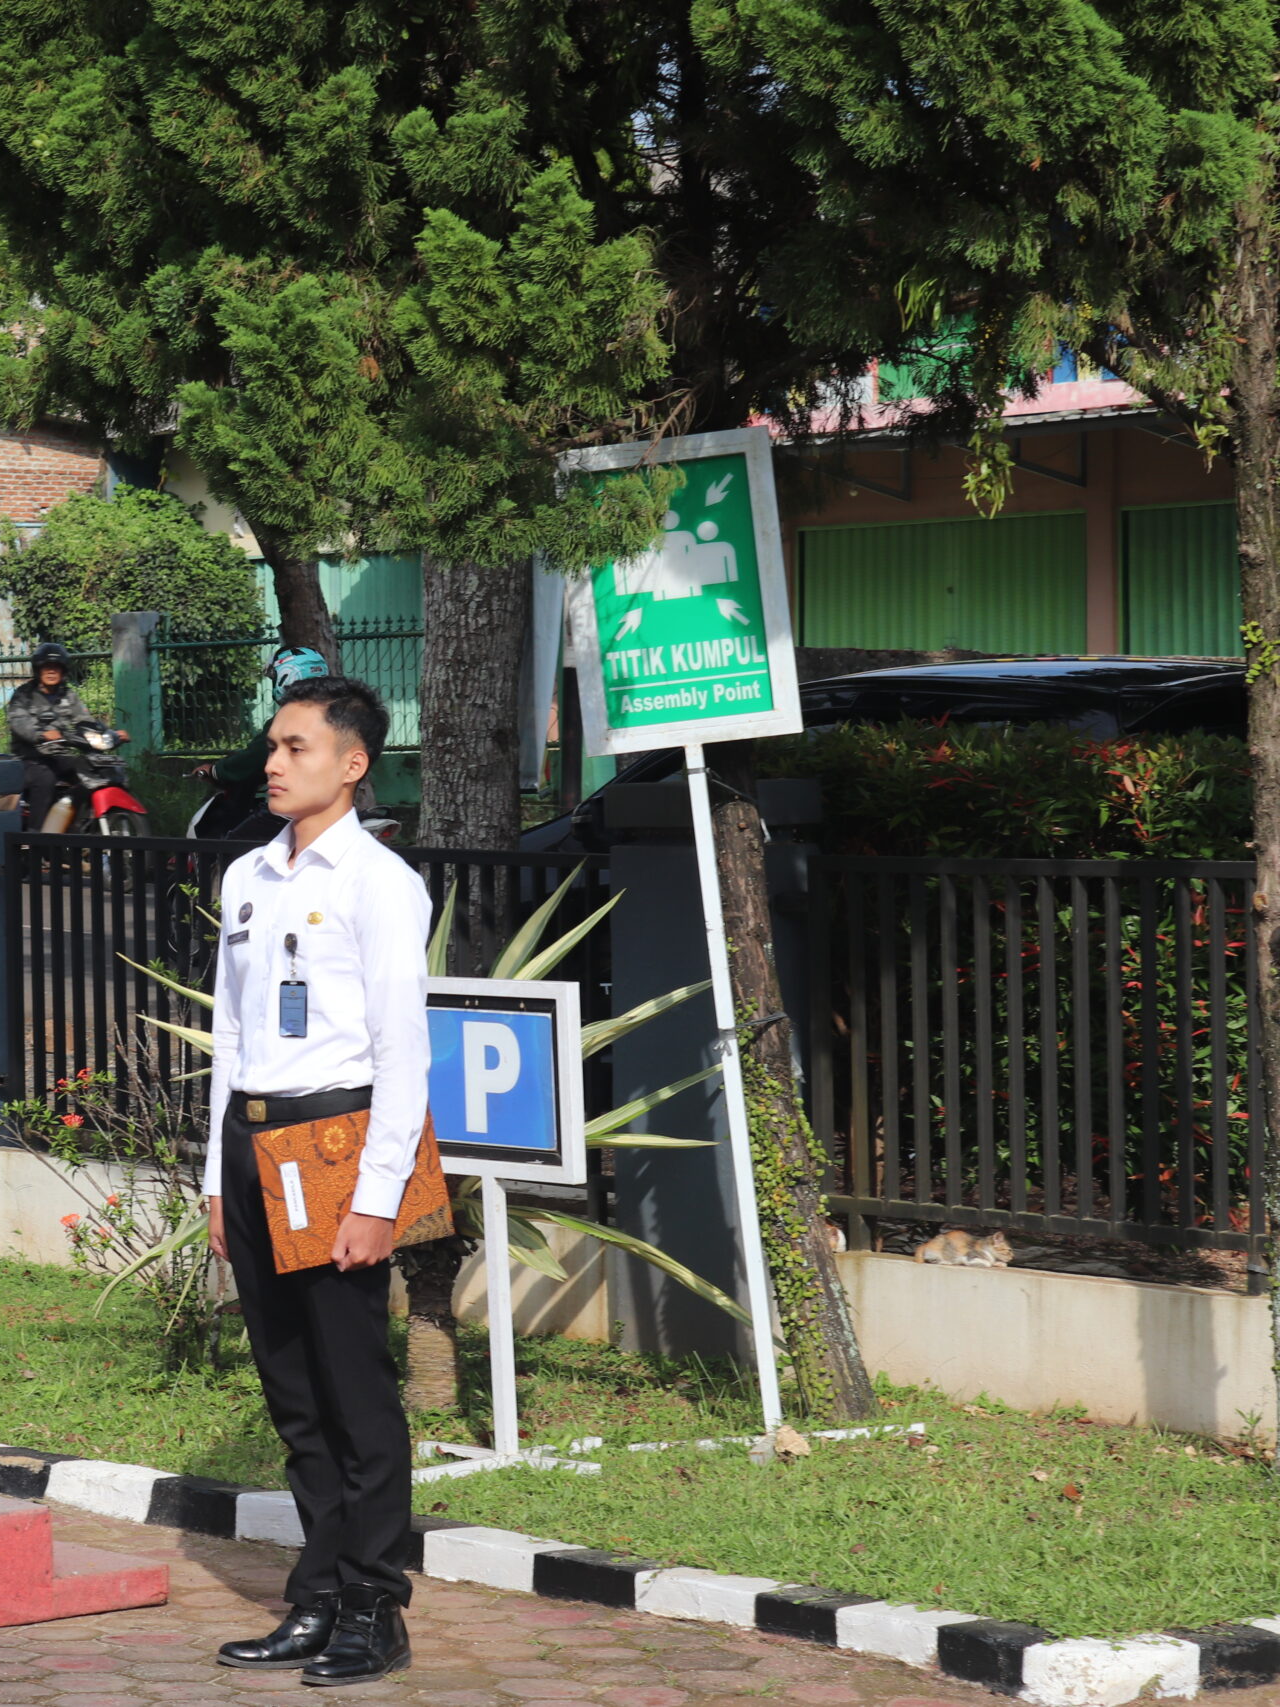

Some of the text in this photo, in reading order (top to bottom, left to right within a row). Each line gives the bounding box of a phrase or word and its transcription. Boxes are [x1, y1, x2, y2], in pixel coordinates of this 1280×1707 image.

[606, 635, 766, 680] TITIK KUMPUL
[621, 680, 761, 714] Assembly Point
[463, 1021, 520, 1133] P
